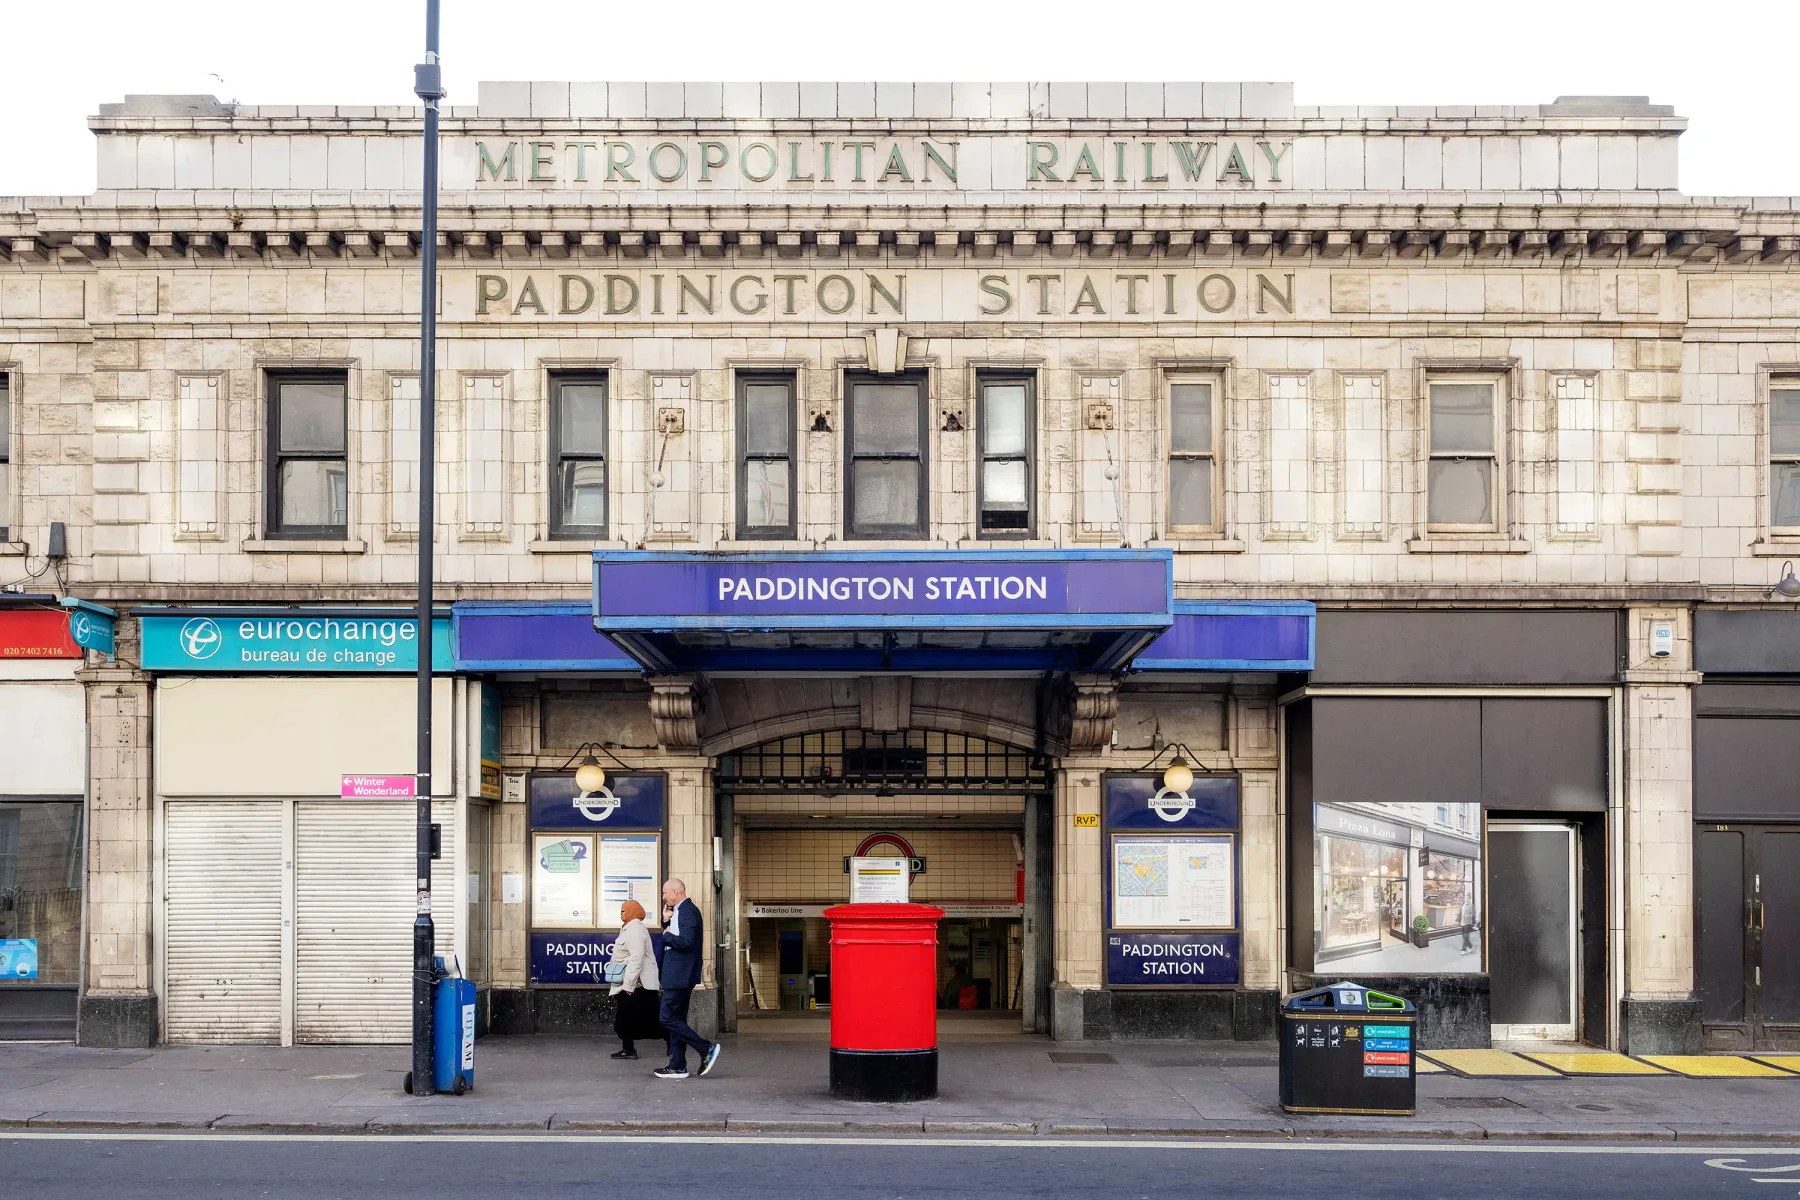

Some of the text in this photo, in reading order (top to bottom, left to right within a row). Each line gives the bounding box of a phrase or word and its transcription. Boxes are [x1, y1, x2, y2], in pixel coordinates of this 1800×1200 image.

[475, 141, 1292, 182] METROPOLITAN RAILWAY
[476, 273, 1295, 315] PADDINGTON STATION
[718, 576, 1048, 601] PADDINGTON STATION
[239, 617, 416, 647] eurochange
[4, 647, 63, 655] 020 7402 7416
[241, 648, 396, 667] bureau de change
[354, 777, 386, 787] Winter
[354, 787, 409, 796] Wonderland
[1076, 816, 1096, 825] RVP
[1339, 817, 1396, 840] Pizza Luna
[546, 943, 615, 956] PADDING
[1122, 944, 1224, 957] PADDINGTON
[566, 961, 610, 974] STATI
[1142, 962, 1204, 975] STATION
